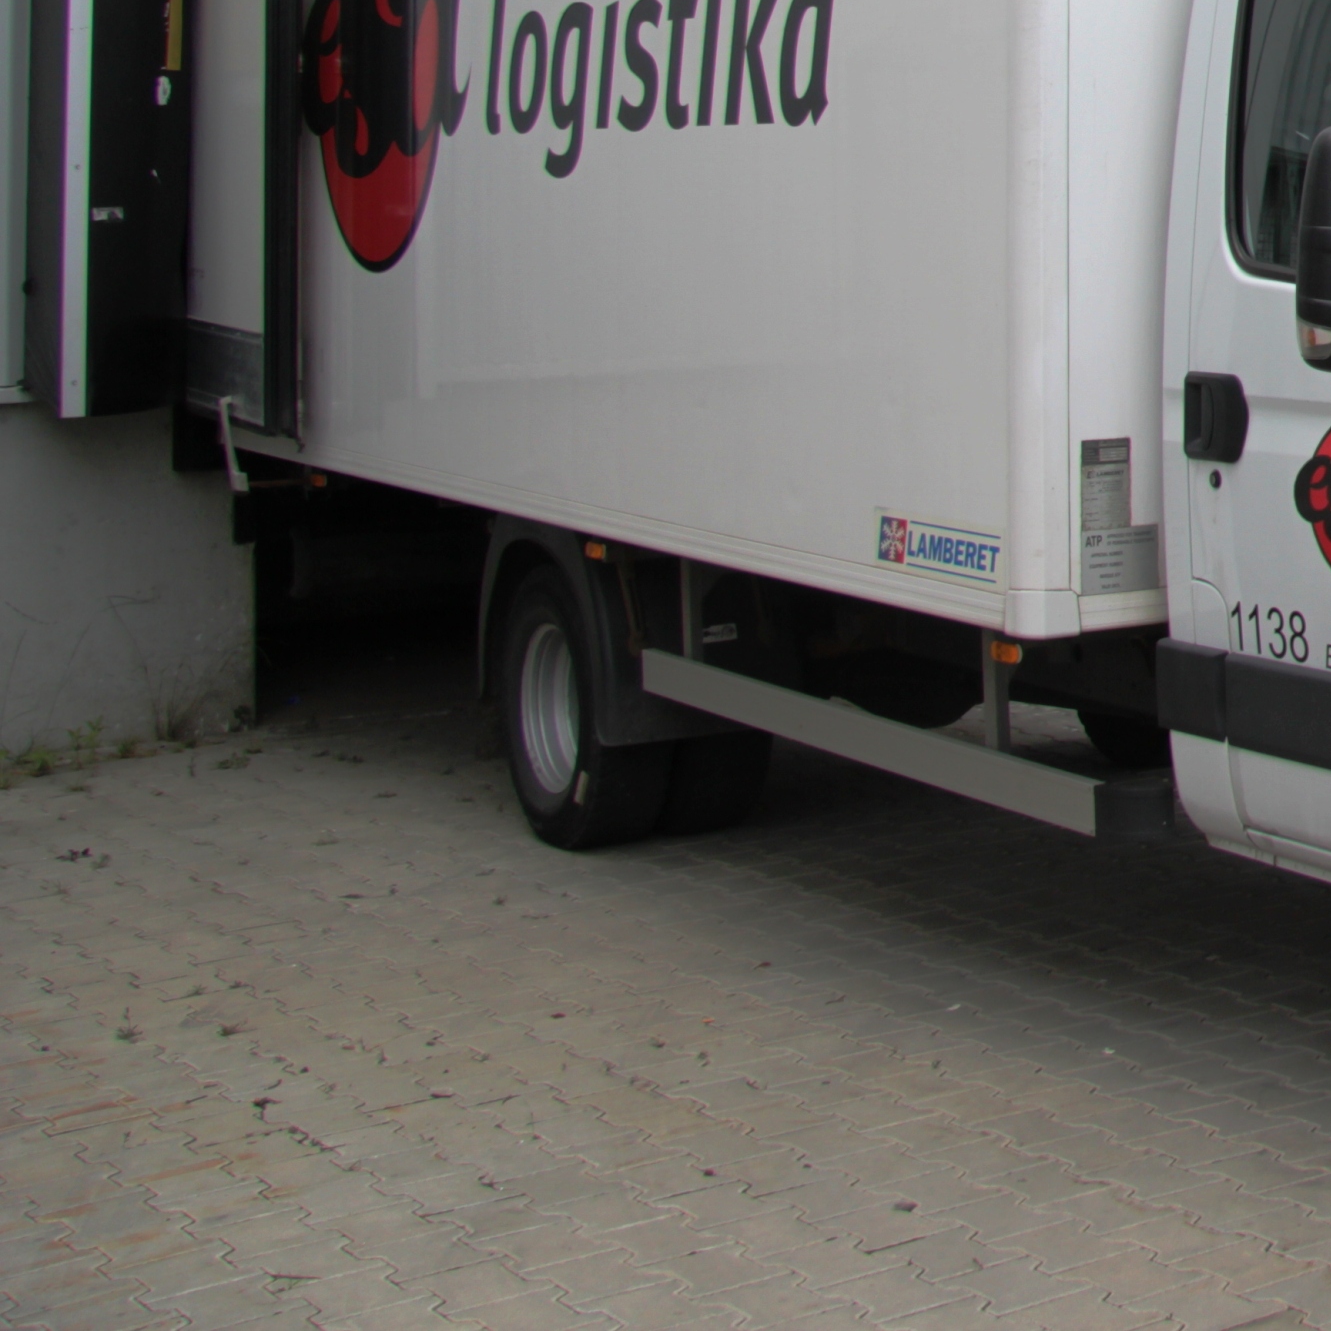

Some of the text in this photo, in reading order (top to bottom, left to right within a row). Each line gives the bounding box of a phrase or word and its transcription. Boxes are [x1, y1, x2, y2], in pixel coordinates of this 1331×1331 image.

[907, 530, 1000, 573] LAMBERET
[1085, 535, 1103, 548] ATP
[1231, 600, 1310, 664] 1138
